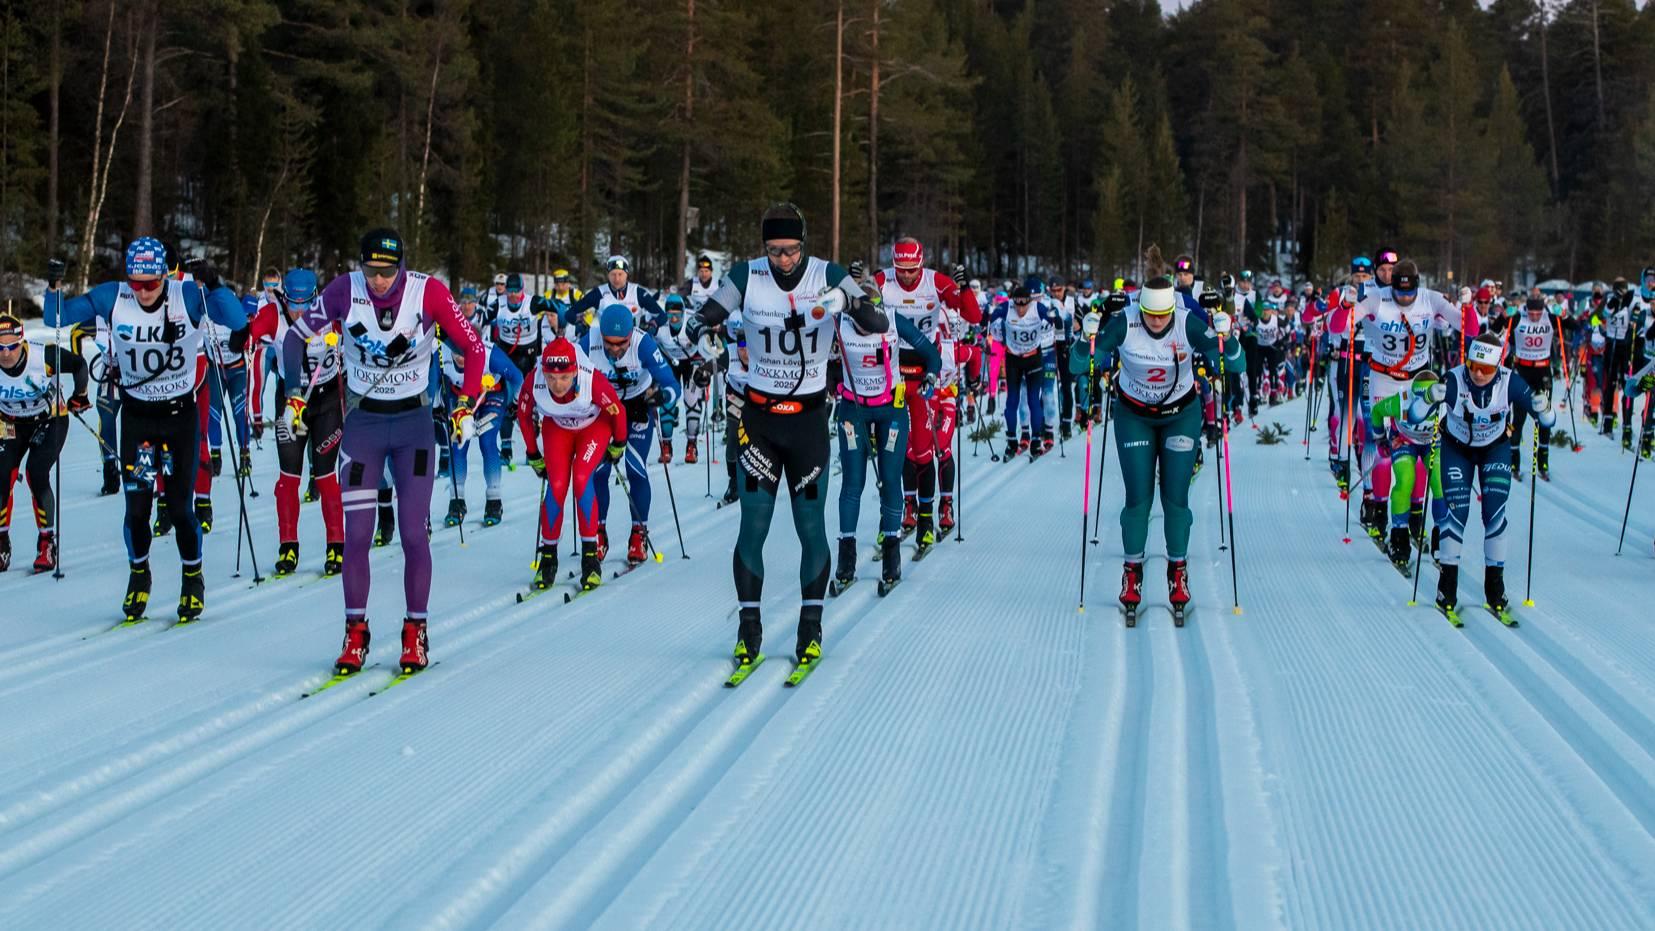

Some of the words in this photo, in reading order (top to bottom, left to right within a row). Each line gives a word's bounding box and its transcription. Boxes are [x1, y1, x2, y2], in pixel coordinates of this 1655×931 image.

[353, 297, 371, 306] BOX
[135, 323, 187, 343] LKB
[758, 327, 820, 356] 101
[1013, 330, 1037, 342] 130
[1382, 333, 1427, 352] 319
[1525, 336, 1543, 348] 30
[125, 346, 186, 374] 103
[353, 367, 420, 386] JOKKMOKK
[1146, 368, 1167, 383] 2
[774, 380, 795, 390] 2025
